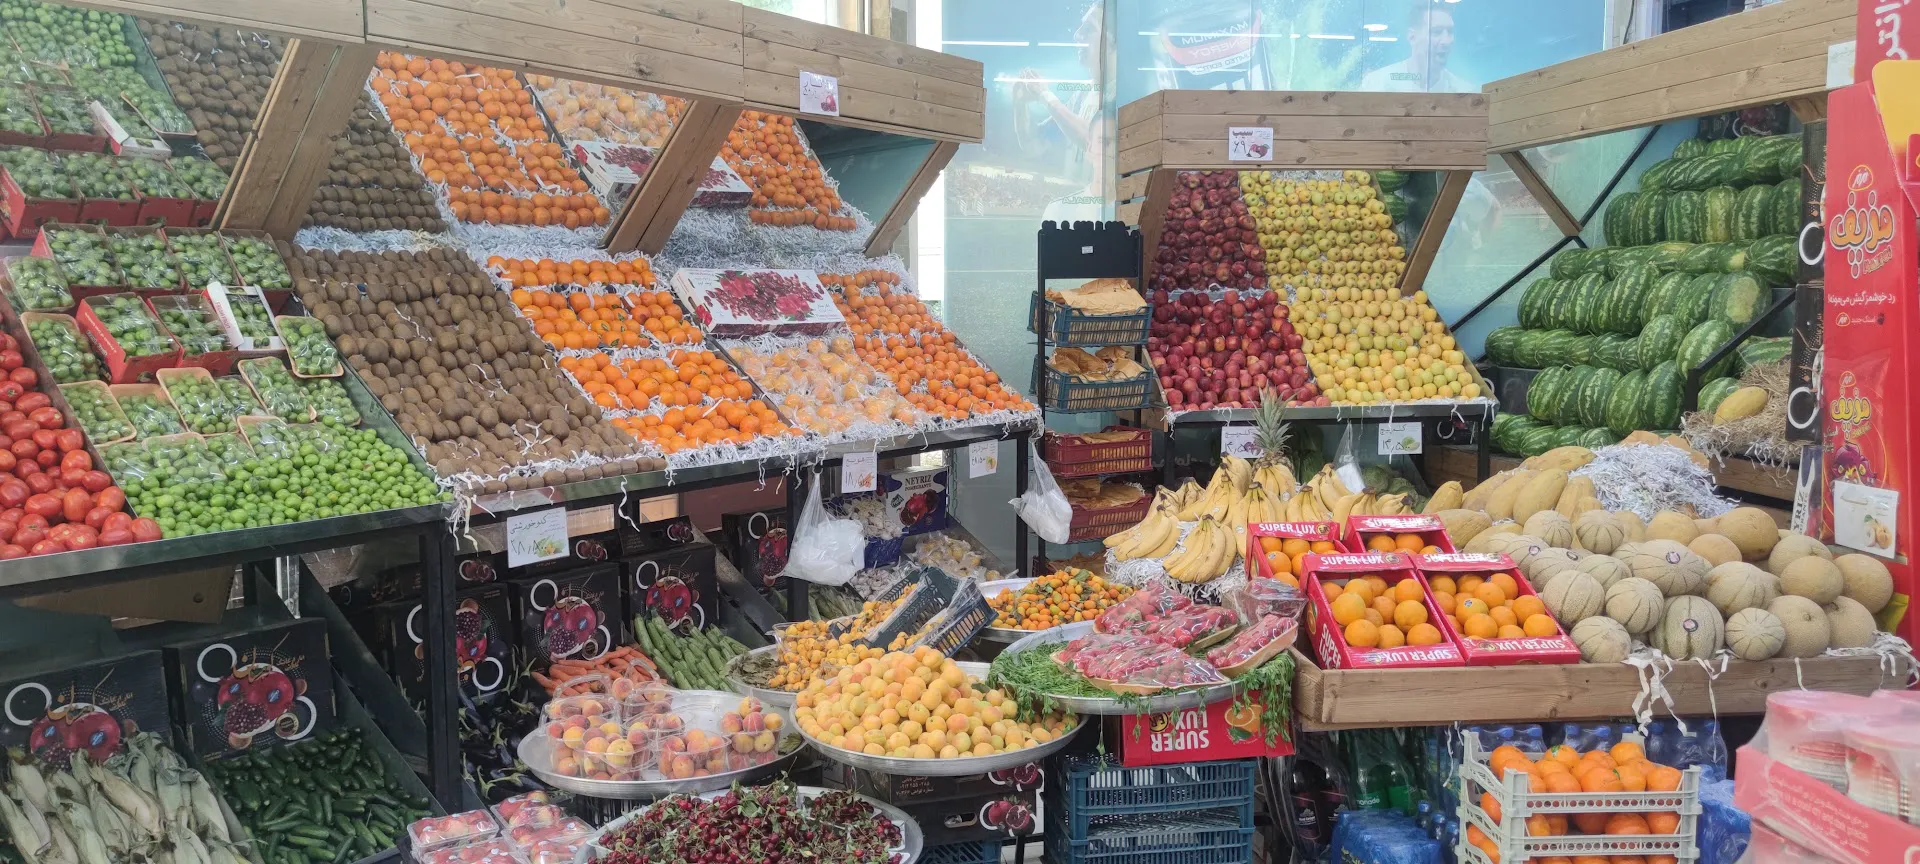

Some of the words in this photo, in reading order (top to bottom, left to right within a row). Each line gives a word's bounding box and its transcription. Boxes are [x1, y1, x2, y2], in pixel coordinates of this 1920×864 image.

[1232, 130, 1254, 139] سیب
[906, 475, 932, 486] NEYRIZ
[1794, 492, 1804, 530] YRIZ
[1259, 523, 1292, 534] SUPER
[1294, 524, 1316, 535] LUX
[1320, 556, 1358, 565] SUPER
[1361, 556, 1384, 564] LUX
[1496, 640, 1523, 650] LUX
[1525, 639, 1566, 650] SUPER
[1385, 651, 1409, 662] LUX
[1409, 650, 1452, 661] SUPER
[1176, 710, 1208, 730] LUX
[1151, 730, 1210, 752] SUPER
